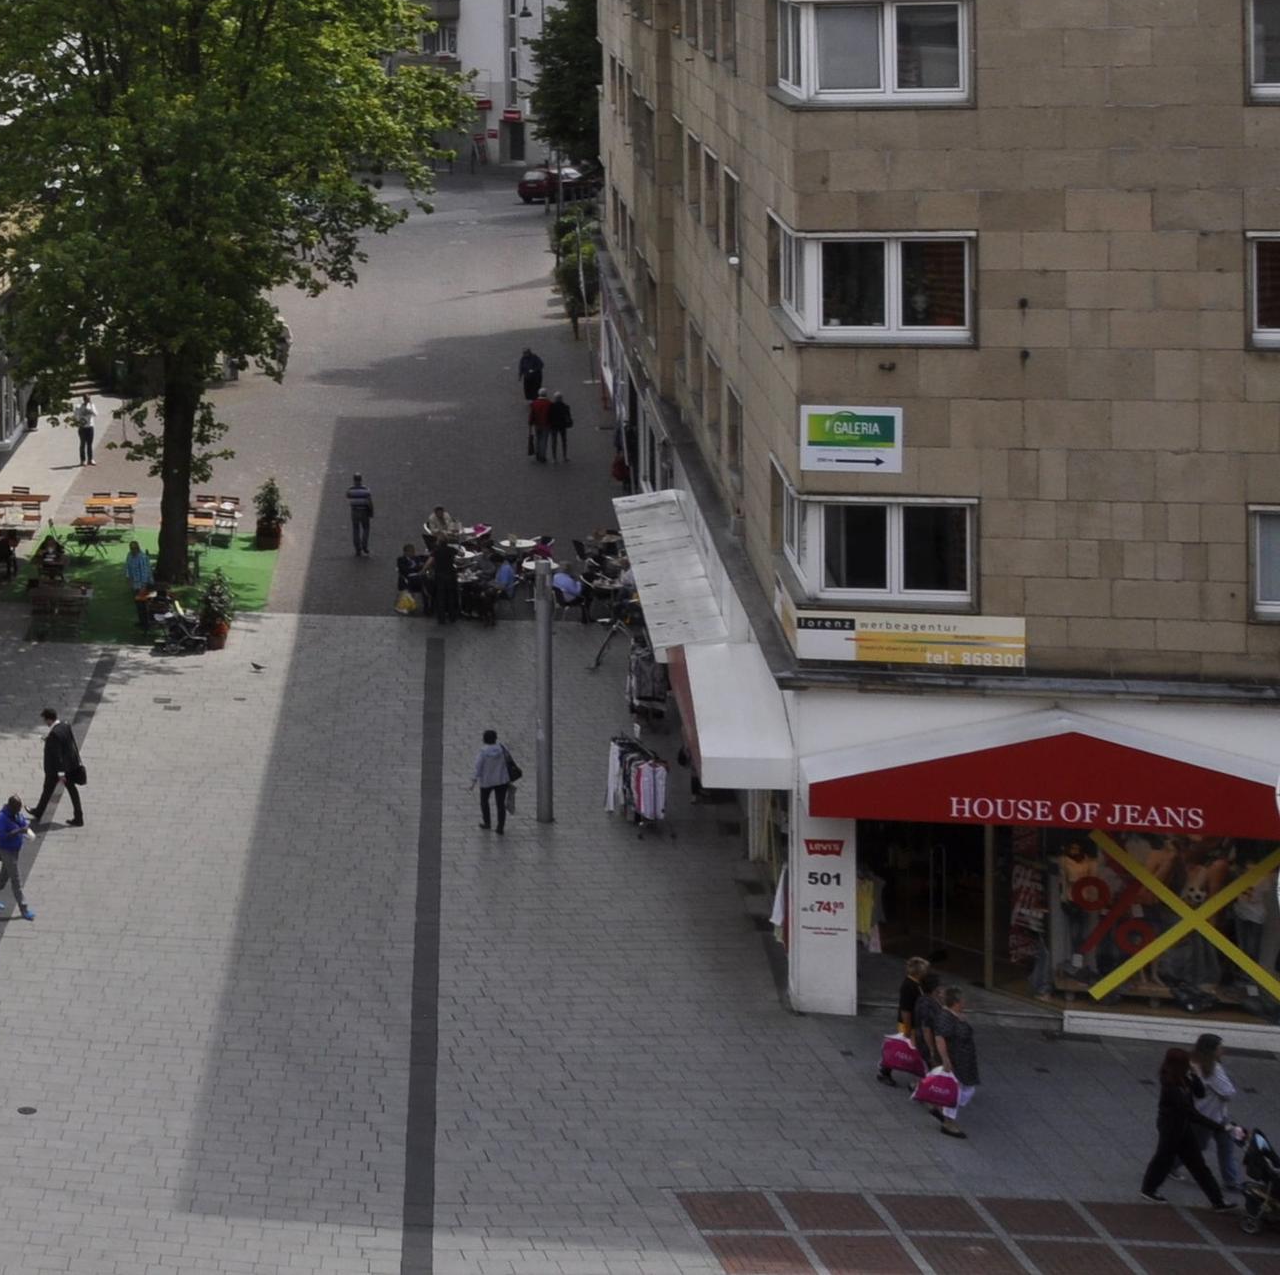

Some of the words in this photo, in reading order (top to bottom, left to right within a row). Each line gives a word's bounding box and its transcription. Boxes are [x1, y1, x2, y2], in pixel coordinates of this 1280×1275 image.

[833, 421, 881, 436] GALERIA
[800, 618, 852, 630] lorenz
[859, 621, 959, 633] werbeagentur
[925, 651, 954, 665] tel:
[949, 796, 1053, 821] HOUSE
[1060, 801, 1101, 823] OF
[1107, 804, 1205, 829] JEANS
[808, 872, 842, 886] 501
